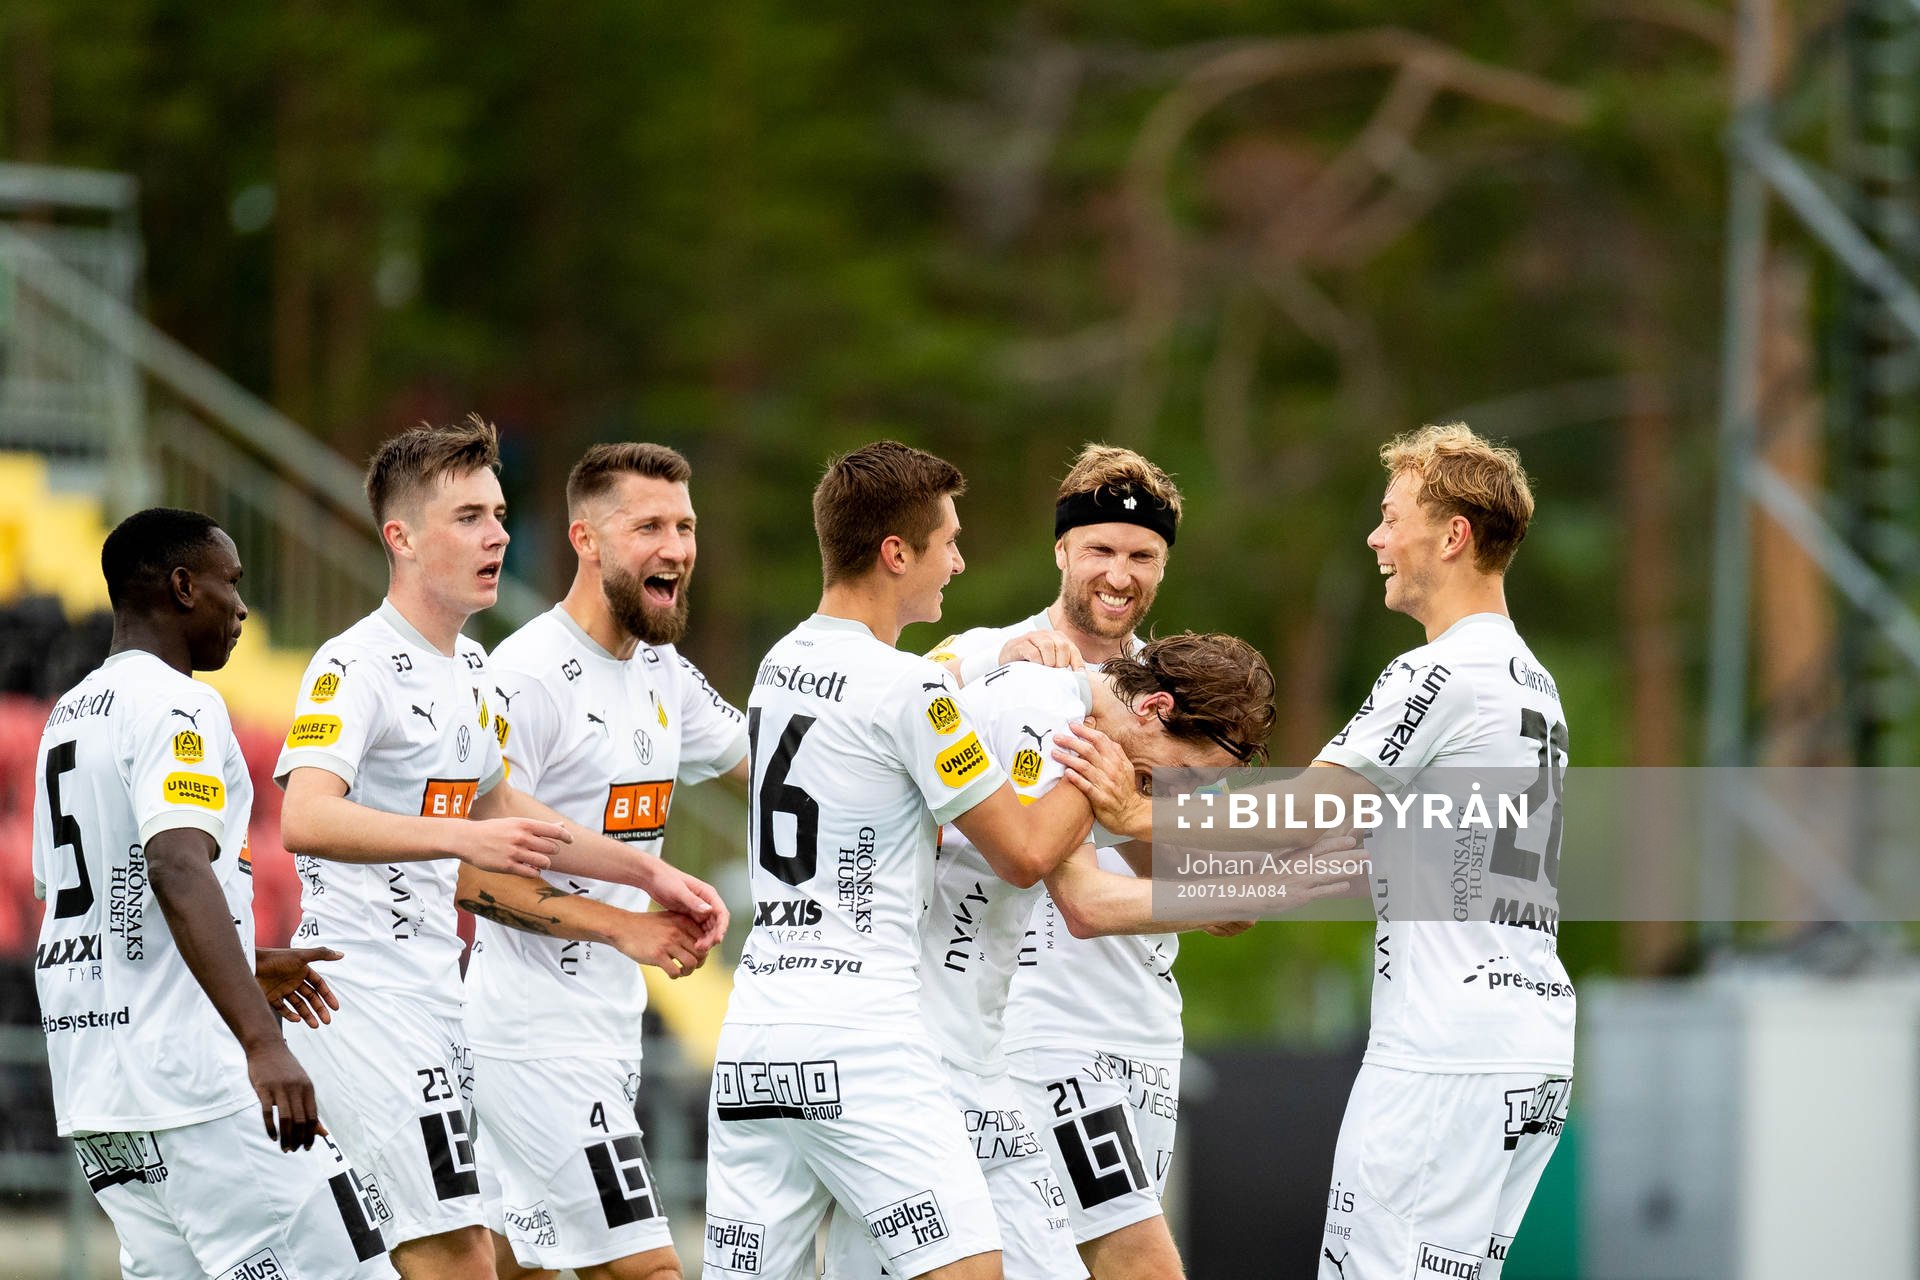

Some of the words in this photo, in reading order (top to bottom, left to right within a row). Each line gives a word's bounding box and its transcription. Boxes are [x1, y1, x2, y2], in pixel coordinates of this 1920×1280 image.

[292, 722, 338, 736] UNIBET
[1378, 664, 1451, 767] stadium
[168, 780, 219, 797] UNIBET
[433, 794, 475, 815] BR
[748, 707, 819, 887] 16
[46, 740, 95, 920] 5
[838, 847, 855, 912] HUSET
[855, 826, 877, 935] GRÖNSAKS
[1470, 830, 1488, 901] HUSET
[110, 866, 127, 938] HUSET
[126, 843, 148, 962] GRÖNSAKS
[754, 899, 823, 927] XXIS
[1489, 896, 1558, 938] MAXX
[68, 966, 102, 982] TYR
[417, 1066, 454, 1103] 23
[1046, 1076, 1087, 1118] 21
[589, 1101, 609, 1133] 4
[803, 1104, 843, 1121] GROUP
[963, 1109, 1025, 1132] ORDIC
[145, 1166, 169, 1185] OUP
[707, 1223, 760, 1250] ngälvs
[868, 1200, 936, 1239] ungälvs
[911, 1217, 944, 1246] trä
[731, 1247, 757, 1272] trä
